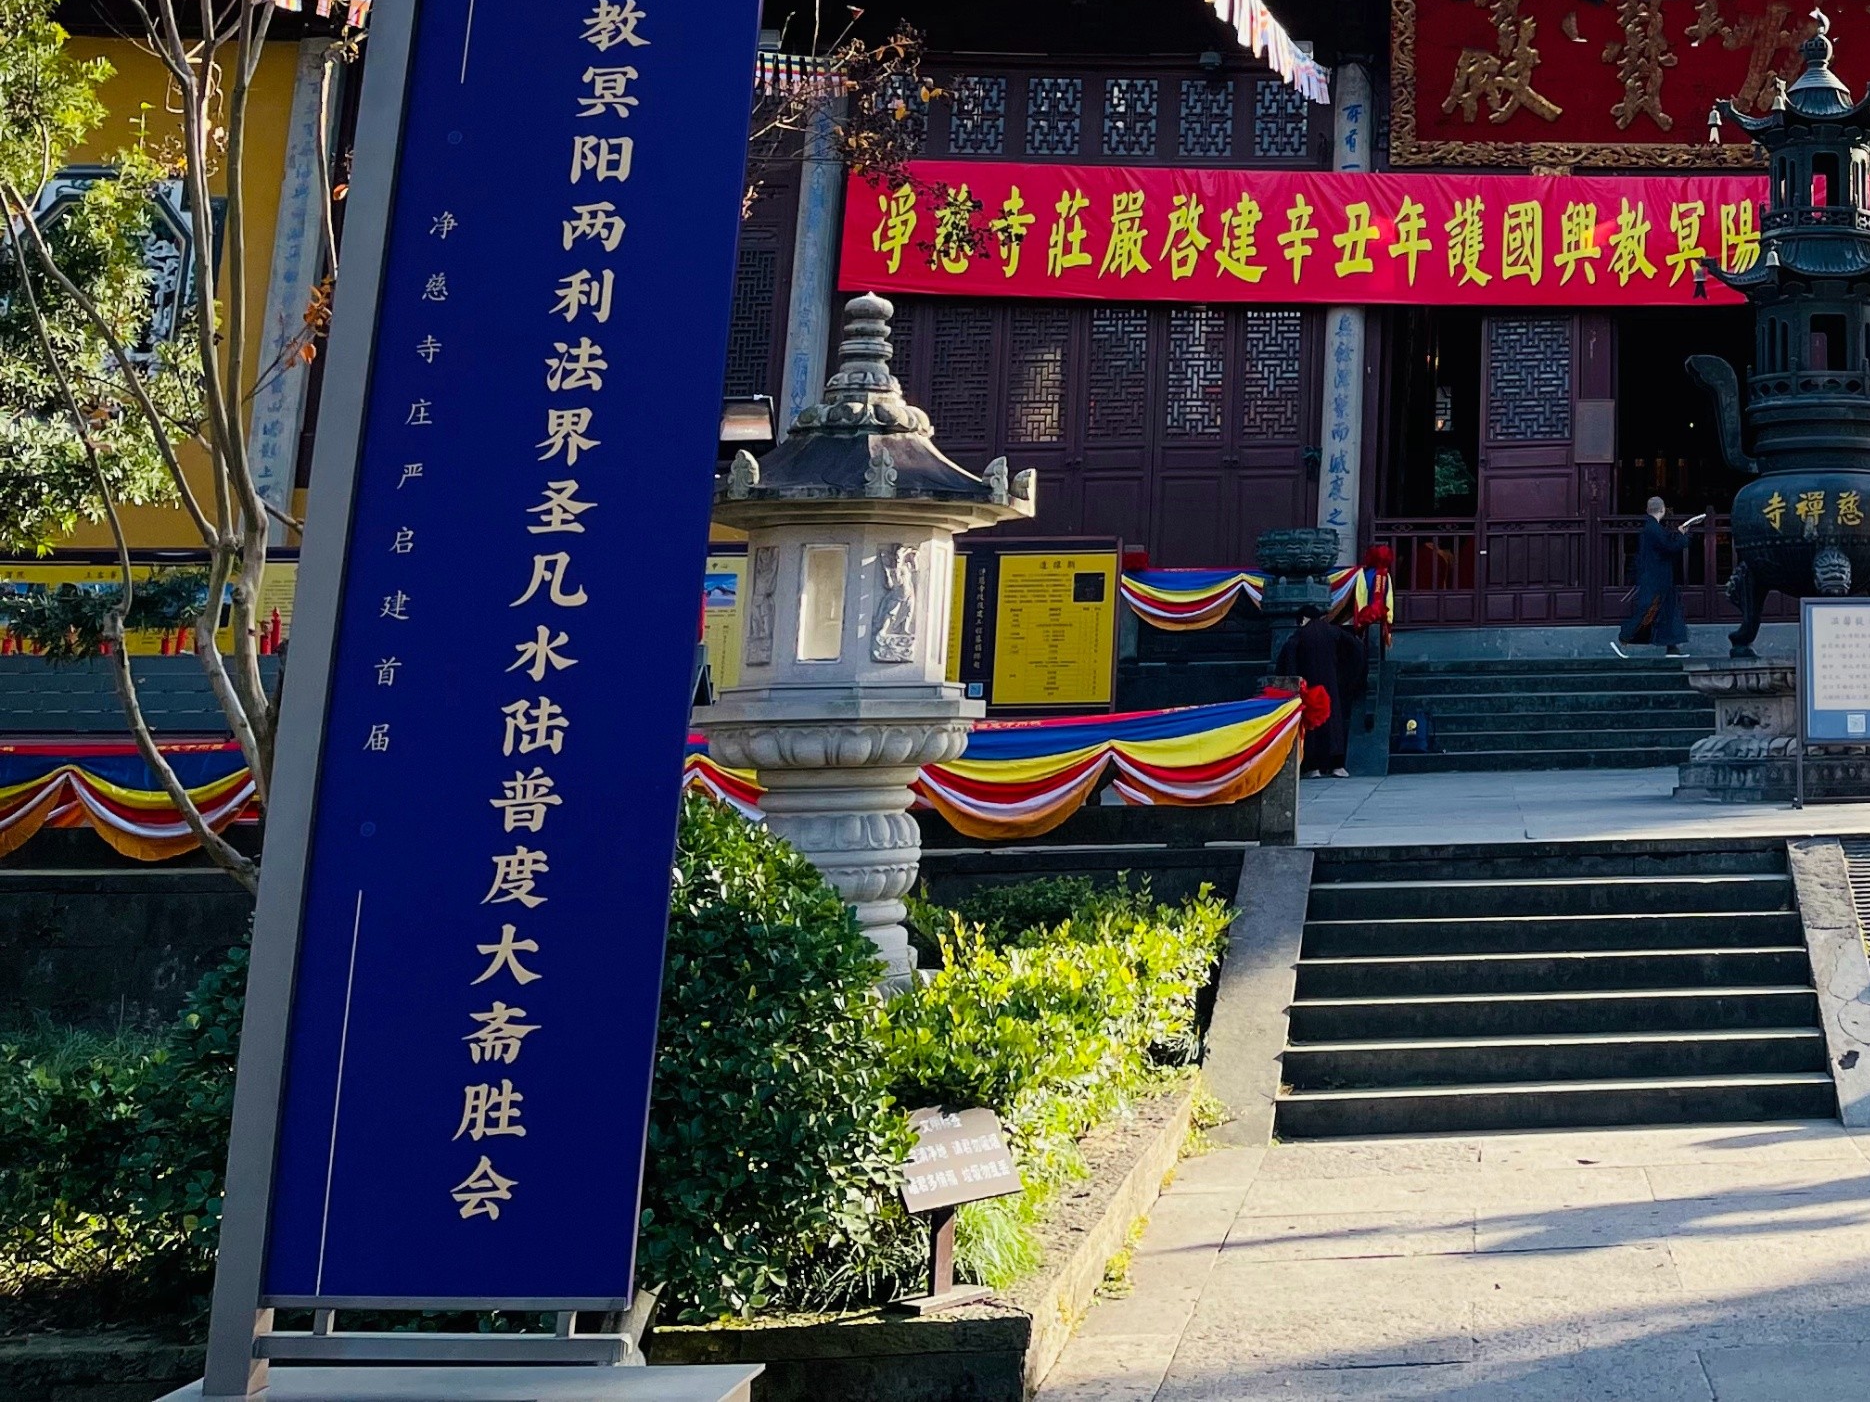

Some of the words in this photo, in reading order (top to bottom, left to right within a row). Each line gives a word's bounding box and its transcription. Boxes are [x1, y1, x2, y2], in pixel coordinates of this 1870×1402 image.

[362, 210, 459, 754] 净慈寺庄严启建首届
